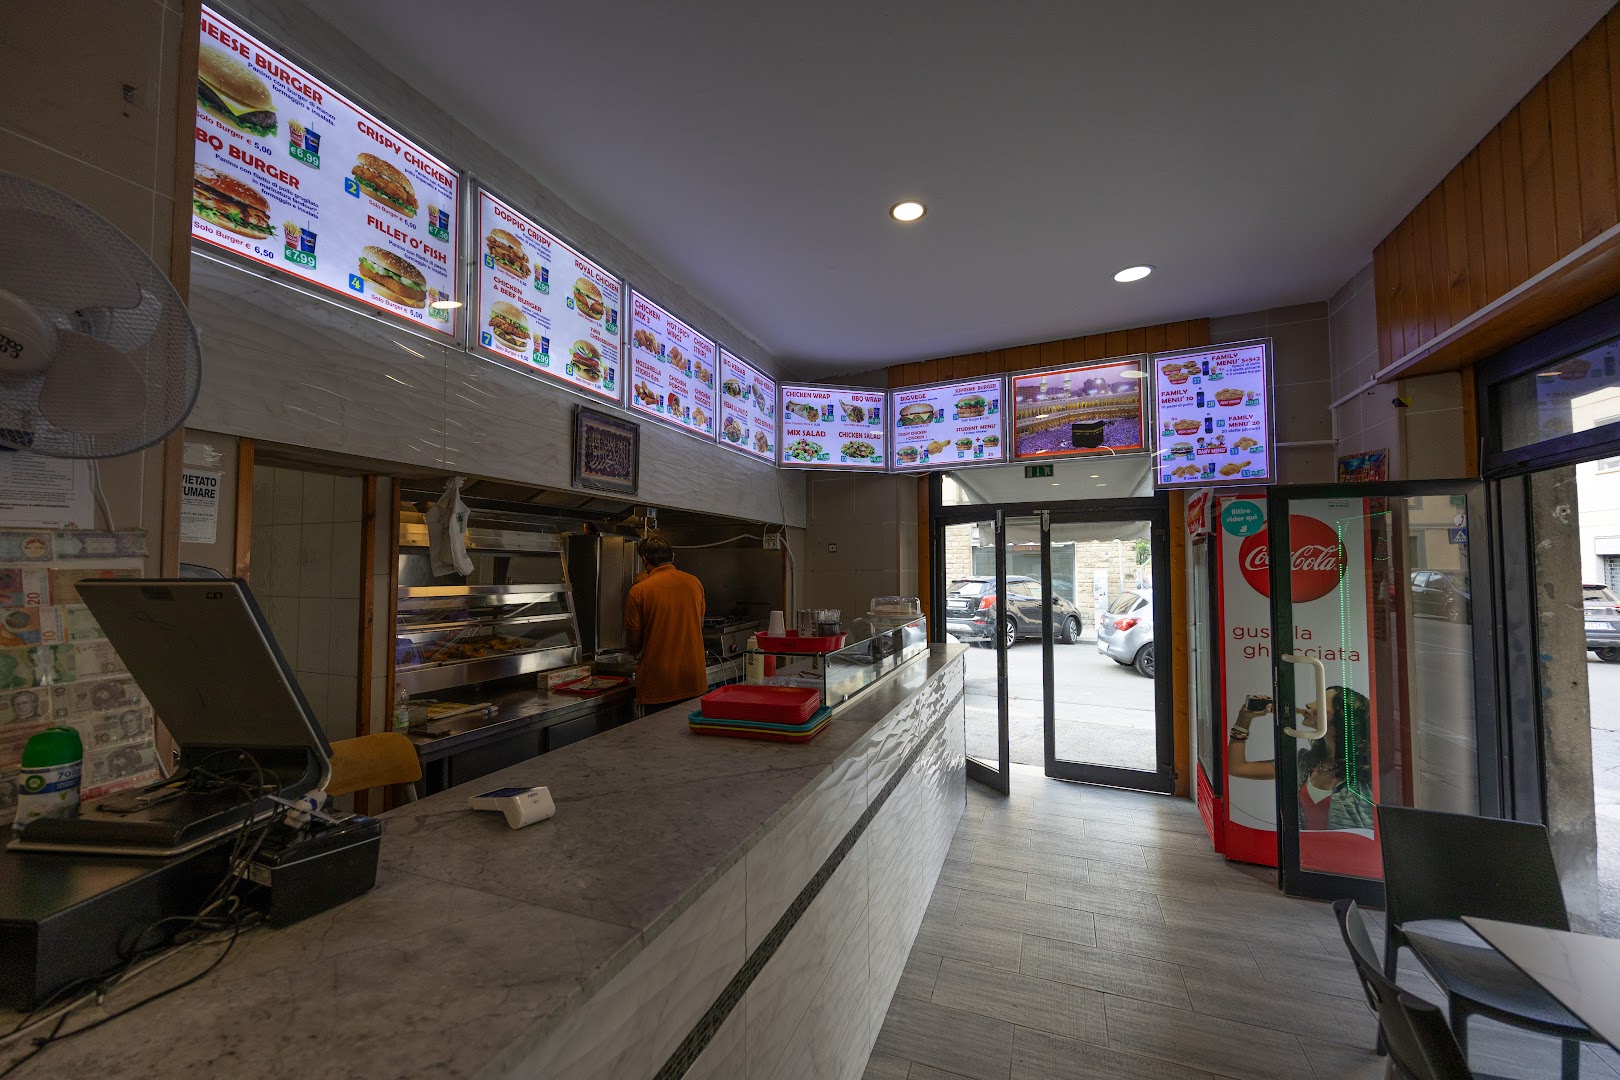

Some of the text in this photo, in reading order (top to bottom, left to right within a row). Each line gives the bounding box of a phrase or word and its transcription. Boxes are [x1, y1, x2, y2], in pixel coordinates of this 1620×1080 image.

[255, 52, 323, 105] BURGER
[248, 62, 272, 81] Panino
[273, 79, 286, 89] con
[287, 86, 308, 103] burger
[316, 106, 336, 120] manzo
[272, 84, 305, 108] formaggio
[216, 121, 244, 142] Burger
[254, 142, 272, 156] 5,00
[357, 120, 453, 190] CRISPY CHICKEN
[228, 143, 300, 191] BURGER
[215, 153, 239, 169] Panino
[239, 166, 252, 176] con
[253, 171, 271, 184] filetto
[278, 185, 293, 196] pollo
[294, 193, 319, 208] grigliato
[348, 182, 357, 194] 2
[259, 182, 291, 201] marinatura
[261, 188, 291, 206] formaggio
[297, 206, 319, 219] insalata
[368, 199, 381, 212] Solo
[381, 206, 399, 221] Burger
[494, 206, 525, 232] DOPPIO
[527, 228, 551, 248] CRISPY
[193, 220, 274, 259] Solo Burger € 6,50
[367, 214, 447, 265] FILLET O' FISH
[388, 239, 406, 252] Panino
[404, 253, 427, 268] formaggio
[485, 254, 493, 269] 5
[351, 277, 361, 290] 4
[575, 259, 594, 278] ROYAL
[596, 273, 619, 294] CHICKEN
[493, 276, 522, 295] CHICKEN
[371, 294, 384, 305] Solo
[385, 299, 404, 313] Burger
[500, 287, 516, 299] BEEF
[518, 296, 542, 312] BURGER
[568, 297, 573, 309] 6
[634, 308, 650, 324] MIX 3
[635, 300, 660, 321] CHICKEN
[667, 320, 677, 331] HOT
[678, 327, 690, 338] SPICY
[667, 328, 682, 342] WINGS
[483, 333, 489, 345] 7
[634, 339, 638, 348] 9
[694, 337, 712, 354] CHICKEN
[1211, 353, 1239, 361] FAMILY
[1216, 358, 1240, 366] MENU'
[567, 363, 572, 375] 8
[635, 358, 661, 376] MOZZARELLA
[669, 375, 686, 387] CHICKEN
[669, 381, 688, 395] POPCORN
[695, 388, 710, 400] CHICKEN
[1161, 389, 1188, 397] FAMILY
[1161, 396, 1185, 404] MENU'
[1228, 420, 1250, 428] MENU'
[838, 431, 881, 440] CHICKEN SALAD
[1226, 513, 1258, 523] rider qui
[27, 592, 41, 605] 20
[43, 630, 56, 642] 10
[57, 770, 71, 779] 70
